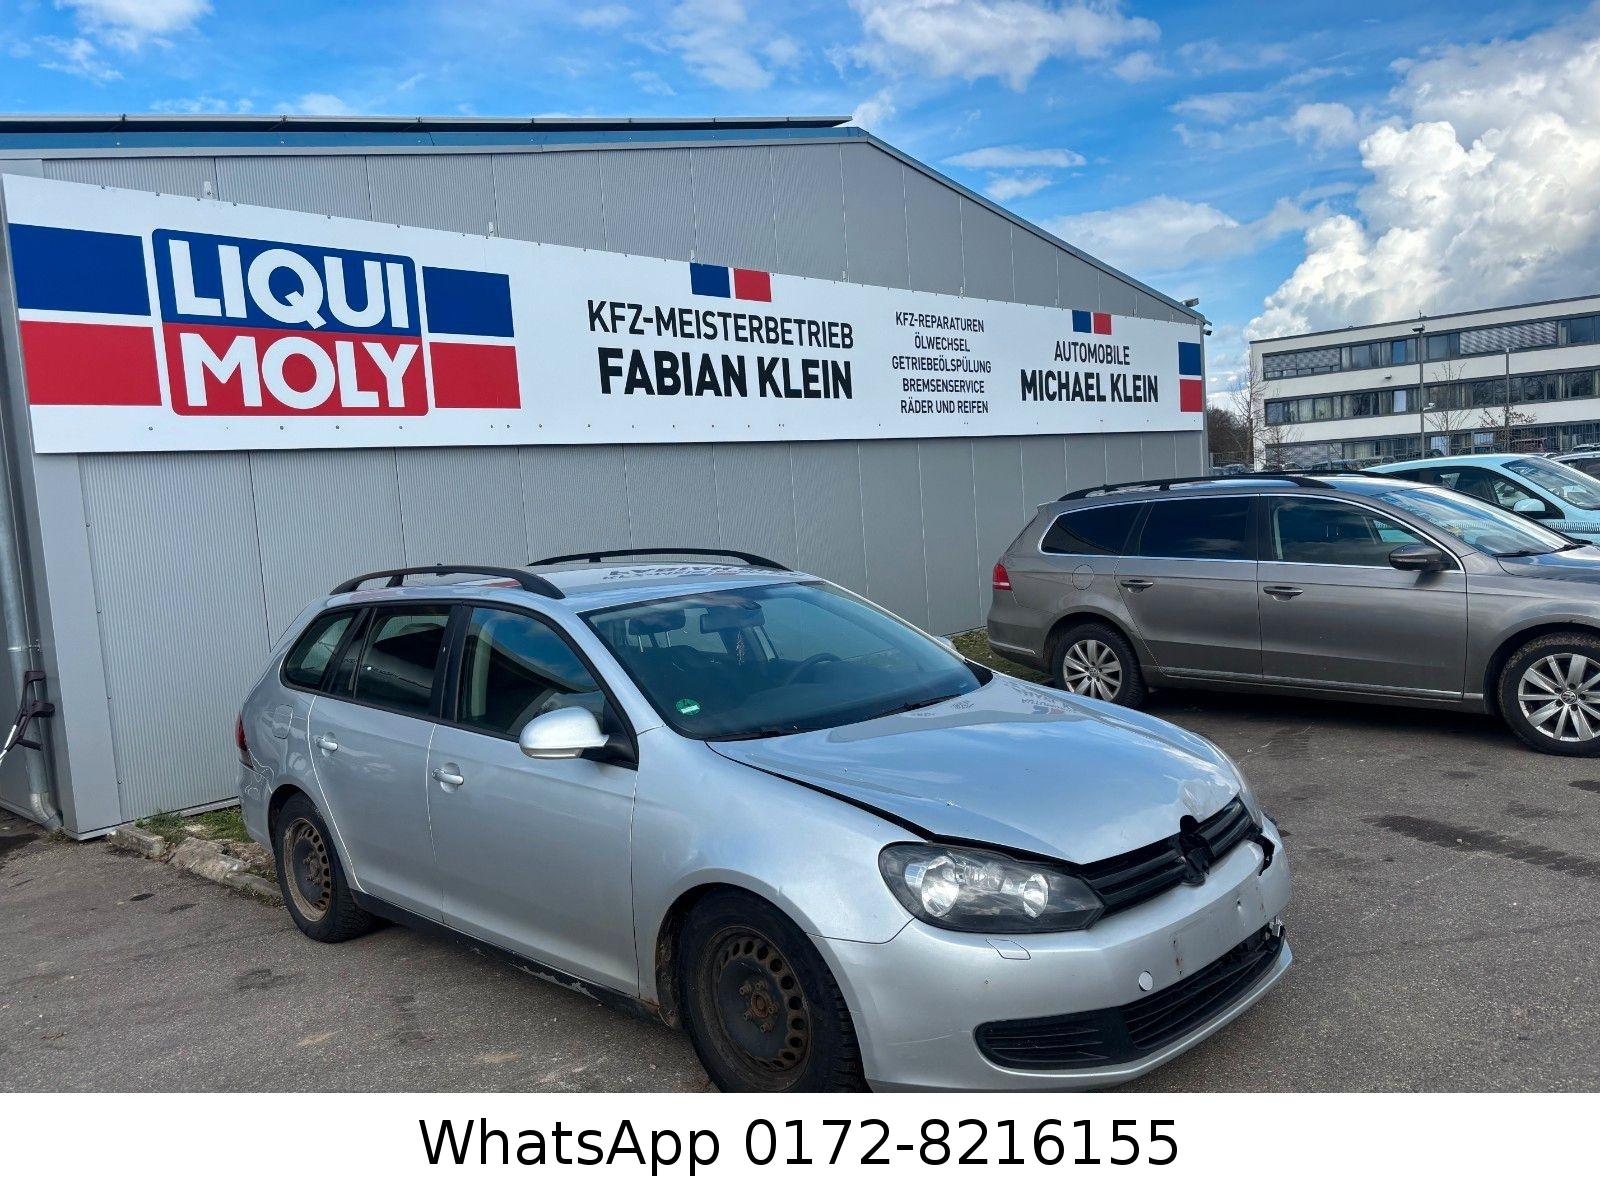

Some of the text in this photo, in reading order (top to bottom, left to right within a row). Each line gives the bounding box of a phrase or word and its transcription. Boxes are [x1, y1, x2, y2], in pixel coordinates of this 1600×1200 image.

[168, 239, 410, 330] LIQUI
[587, 299, 854, 350] KFZ-MEISTERBETRIEB
[895, 311, 985, 333] KFZ-REPARATUREN
[914, 331, 971, 353] ÖLWECHSEL
[1053, 340, 1131, 366] AUTOMOBILE
[179, 332, 420, 410] MOLY
[597, 346, 853, 400] FABIAN KLEIN
[891, 355, 992, 374] GETRIEBEÖLSPÜLUNG
[902, 377, 985, 394] BREMSENSERVICE
[1020, 368, 1159, 403] MICHAEL KLEIN
[900, 396, 989, 414] RÄDER UND REIFEN
